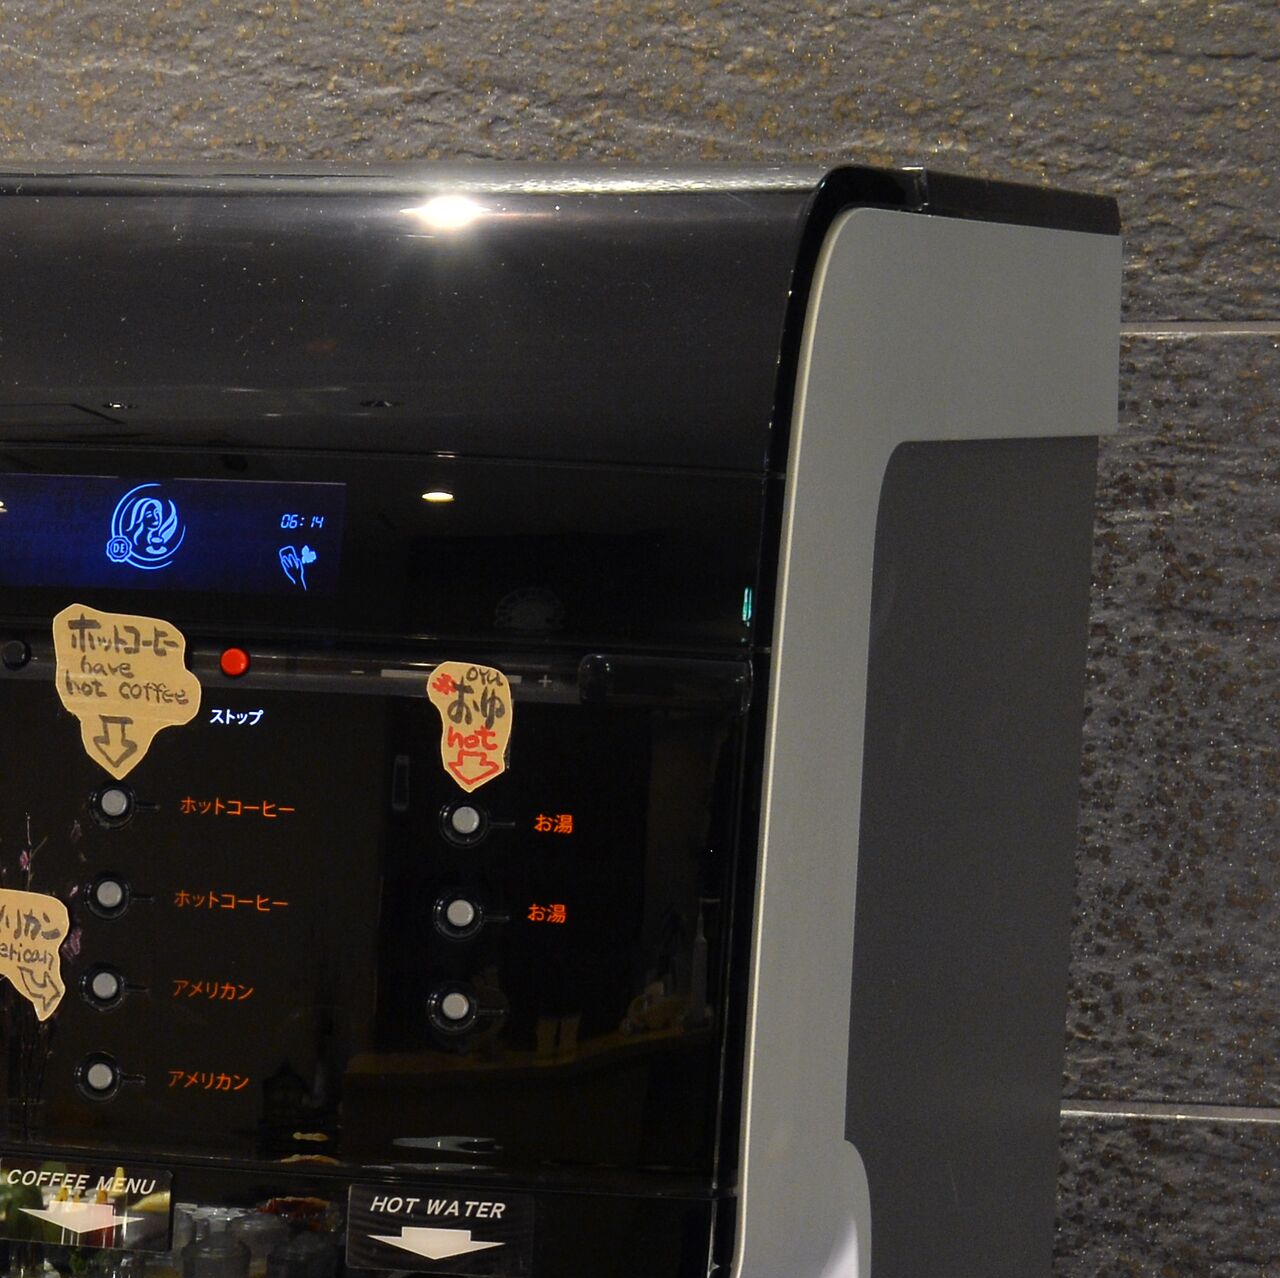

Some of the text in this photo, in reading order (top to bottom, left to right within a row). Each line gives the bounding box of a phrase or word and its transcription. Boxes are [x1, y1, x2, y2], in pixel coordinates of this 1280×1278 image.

[280, 514, 324, 529] 06:14
[112, 543, 126, 554] DE
[68, 613, 179, 657] ホットコーヒー
[80, 654, 134, 678] have
[65, 675, 189, 705] hot coffee
[447, 679, 506, 730] おゆ
[209, 707, 265, 727] ストップ
[447, 725, 498, 750] hot
[179, 796, 296, 818] ホットコーヒー
[533, 813, 573, 834] お湯
[173, 889, 289, 912] ホットコーヒー
[527, 903, 567, 924] お湯
[172, 979, 254, 1001] アメリカン
[167, 1070, 250, 1091] アメリカン
[6, 1168, 156, 1197] COFFEE MENU
[370, 1196, 506, 1220] HOT WATER
